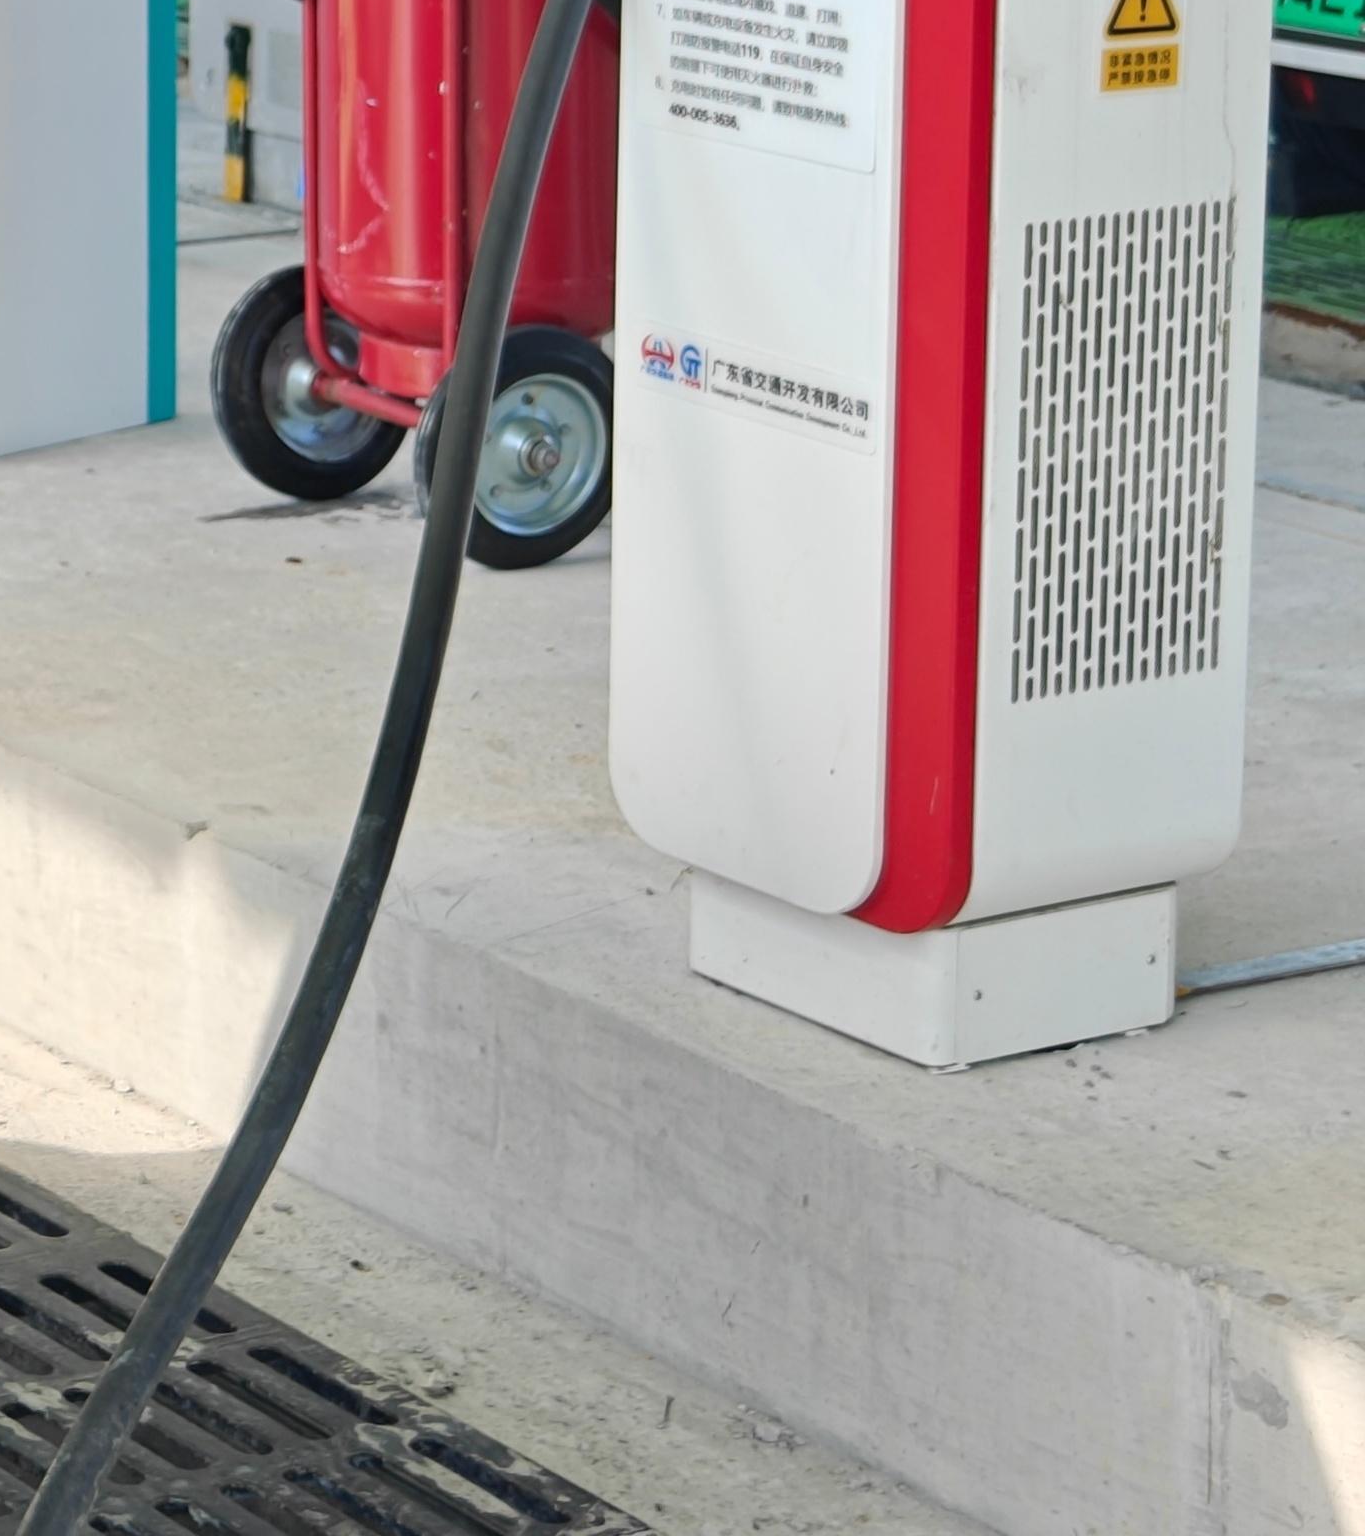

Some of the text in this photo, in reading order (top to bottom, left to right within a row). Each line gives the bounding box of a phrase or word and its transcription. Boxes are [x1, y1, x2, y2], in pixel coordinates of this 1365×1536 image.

[1109, 50, 1172, 68] 非紧急情况
[1107, 68, 1170, 86] 严禁按急停
[711, 359, 870, 422] 广东省交通开发有限公司
